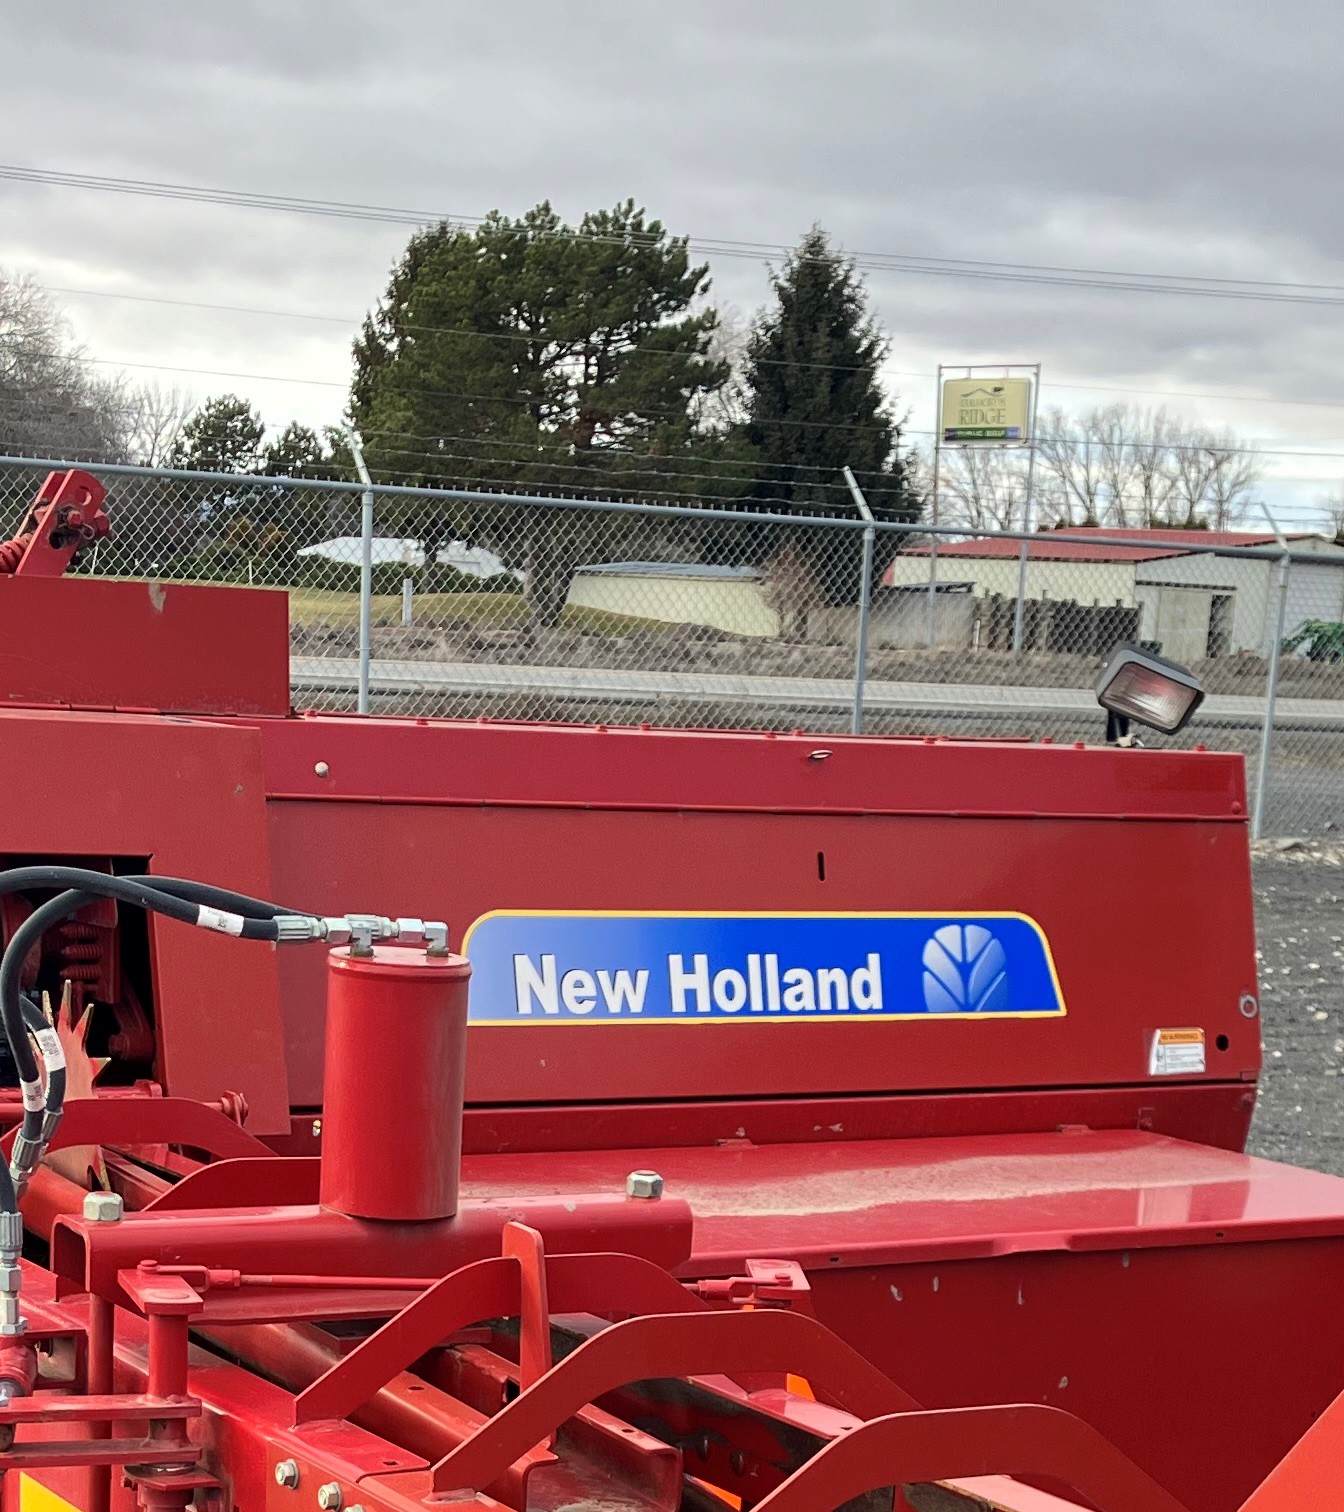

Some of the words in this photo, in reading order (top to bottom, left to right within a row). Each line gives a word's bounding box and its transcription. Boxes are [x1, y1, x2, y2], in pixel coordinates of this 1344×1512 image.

[959, 409, 1006, 425] RIDGE
[513, 953, 650, 1015] New
[668, 952, 884, 1013] Holland
